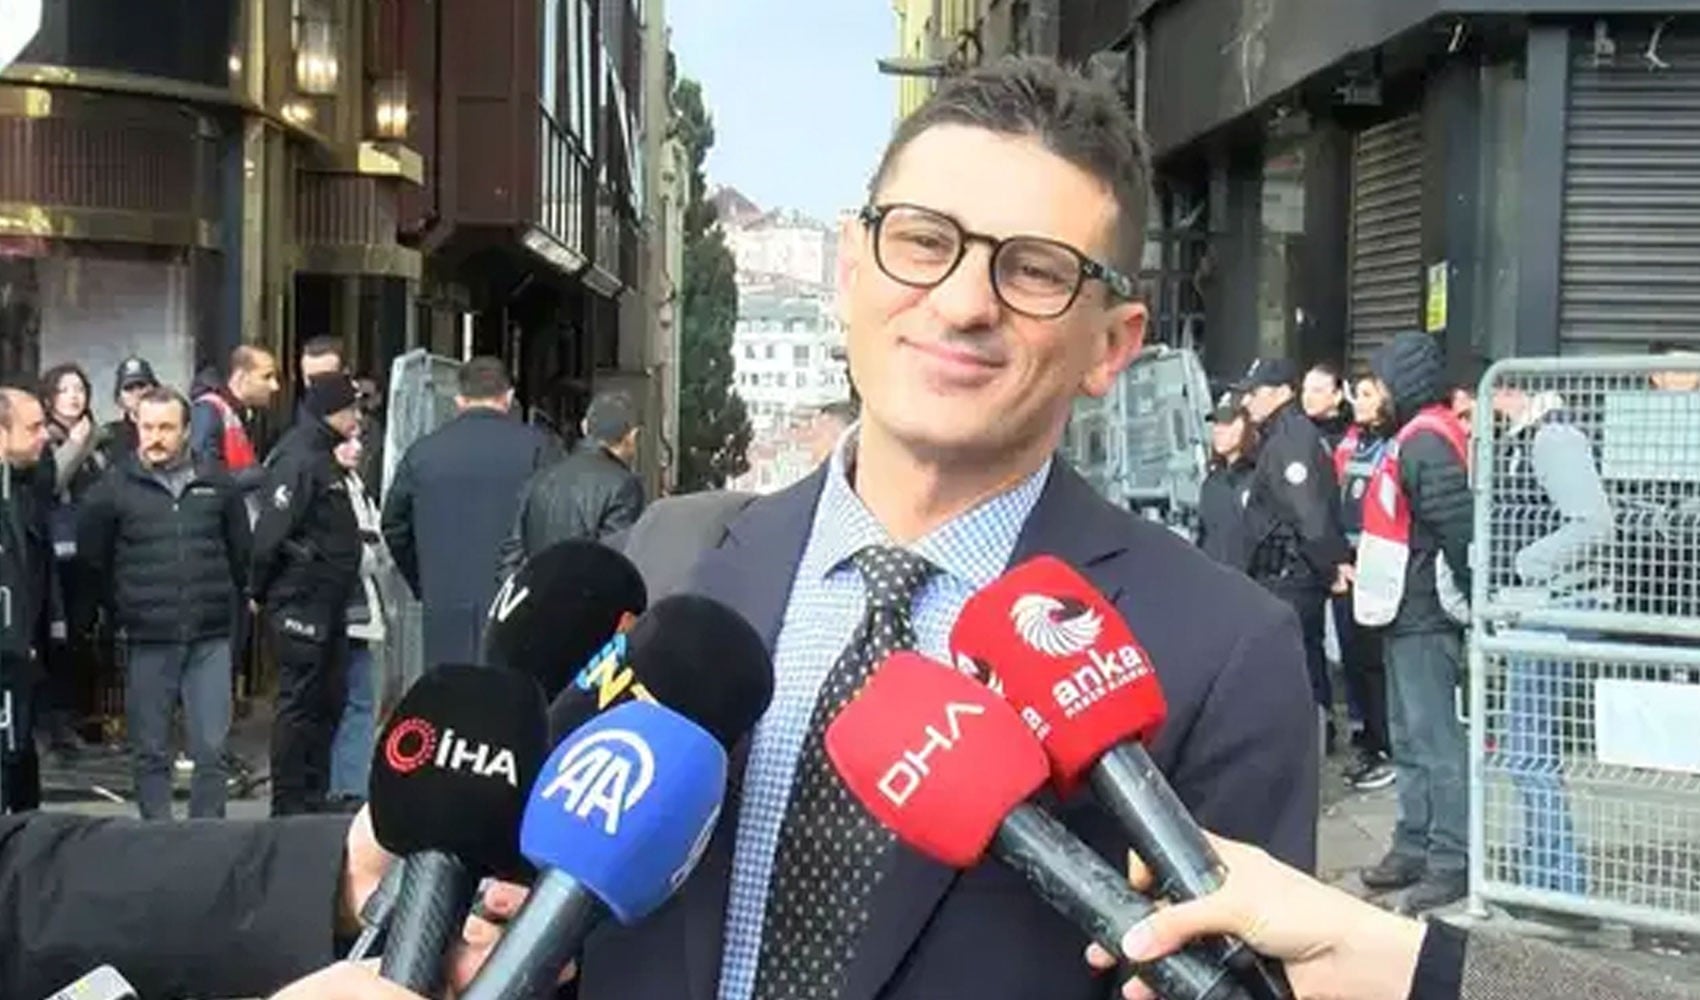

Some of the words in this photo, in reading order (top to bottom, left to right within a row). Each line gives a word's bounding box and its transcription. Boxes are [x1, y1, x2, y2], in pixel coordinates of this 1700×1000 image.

[1052, 645, 1142, 708] anka
[434, 728, 518, 787] İHA
[542, 747, 632, 835] AA
[877, 702, 985, 807] DHA
